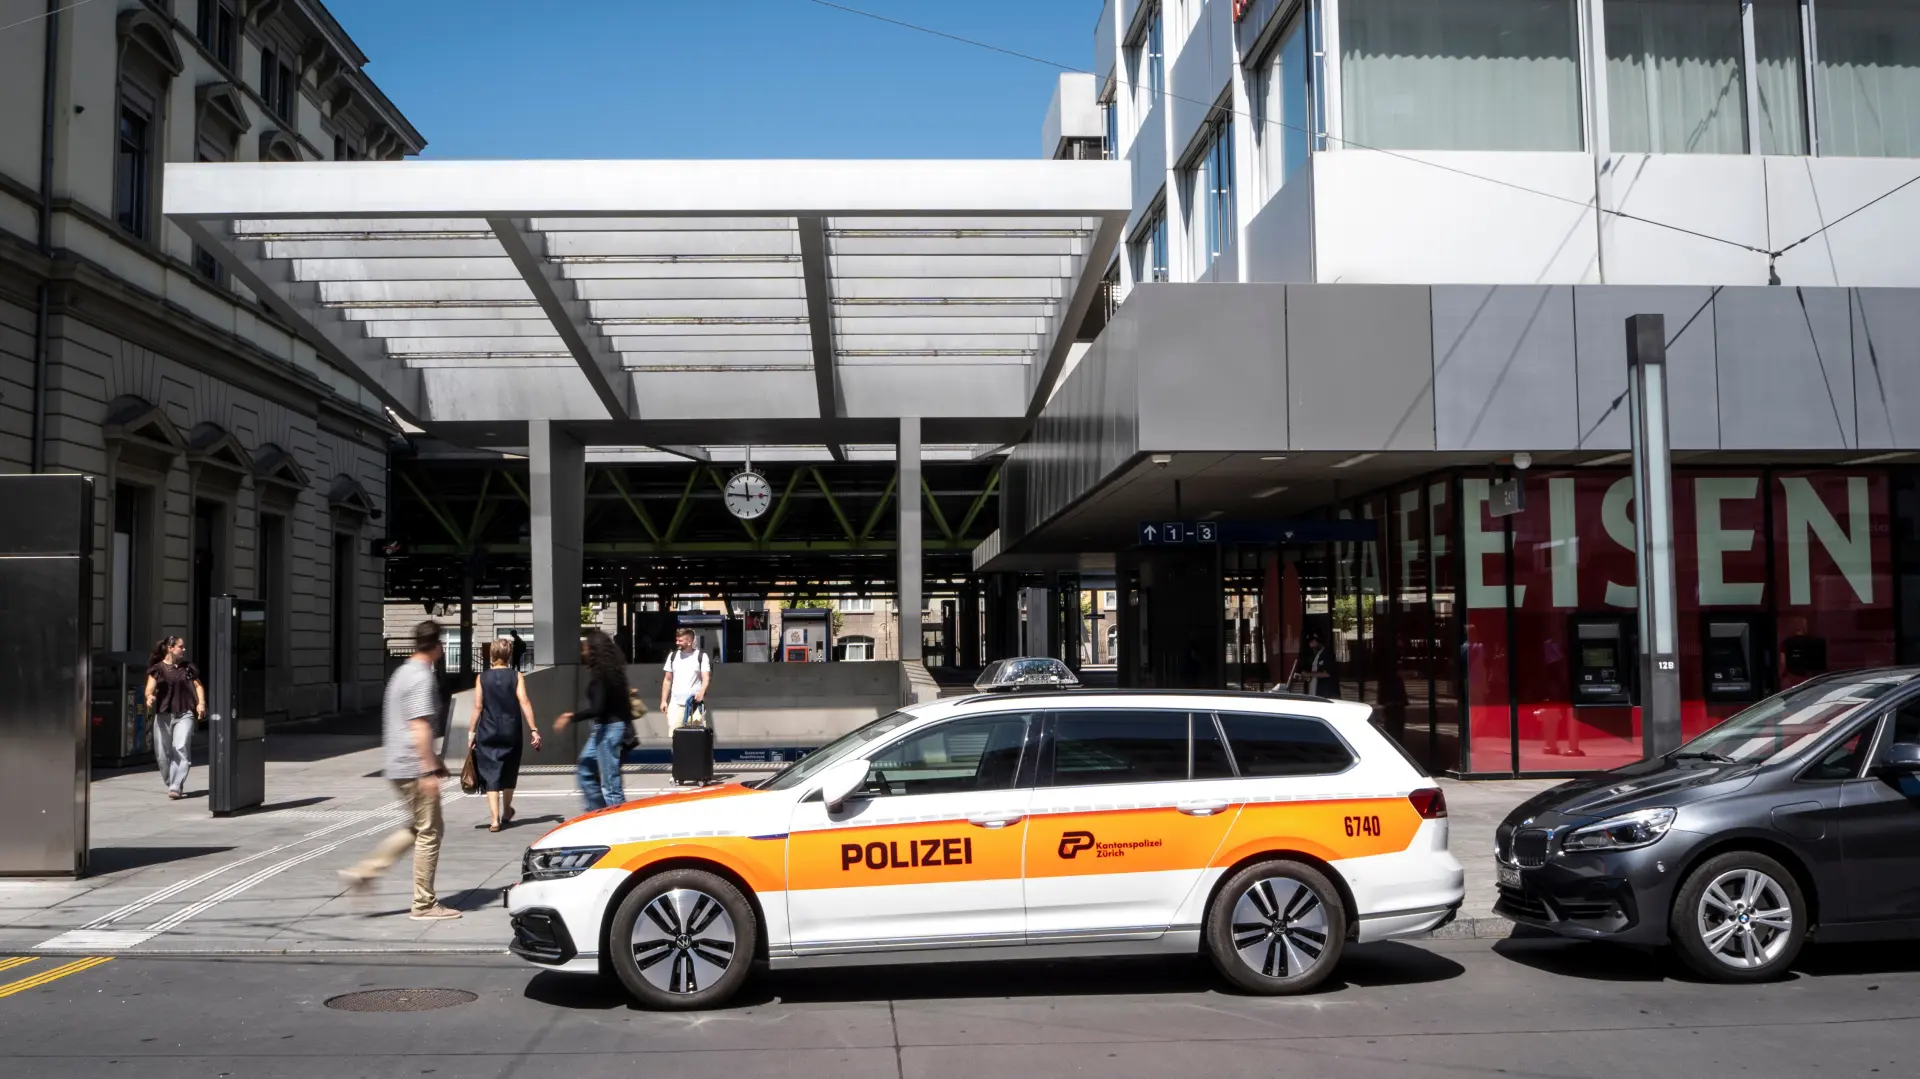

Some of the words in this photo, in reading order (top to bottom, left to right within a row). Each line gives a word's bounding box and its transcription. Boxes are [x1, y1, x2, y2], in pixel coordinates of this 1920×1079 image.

[1170, 528, 1176, 540] 1
[1202, 527, 1212, 540] 3
[1344, 815, 1381, 837] 6740
[1095, 839, 1163, 850] Kantonspolizei
[841, 837, 973, 871] POLIZEI
[1096, 849, 1125, 858] Zürich
